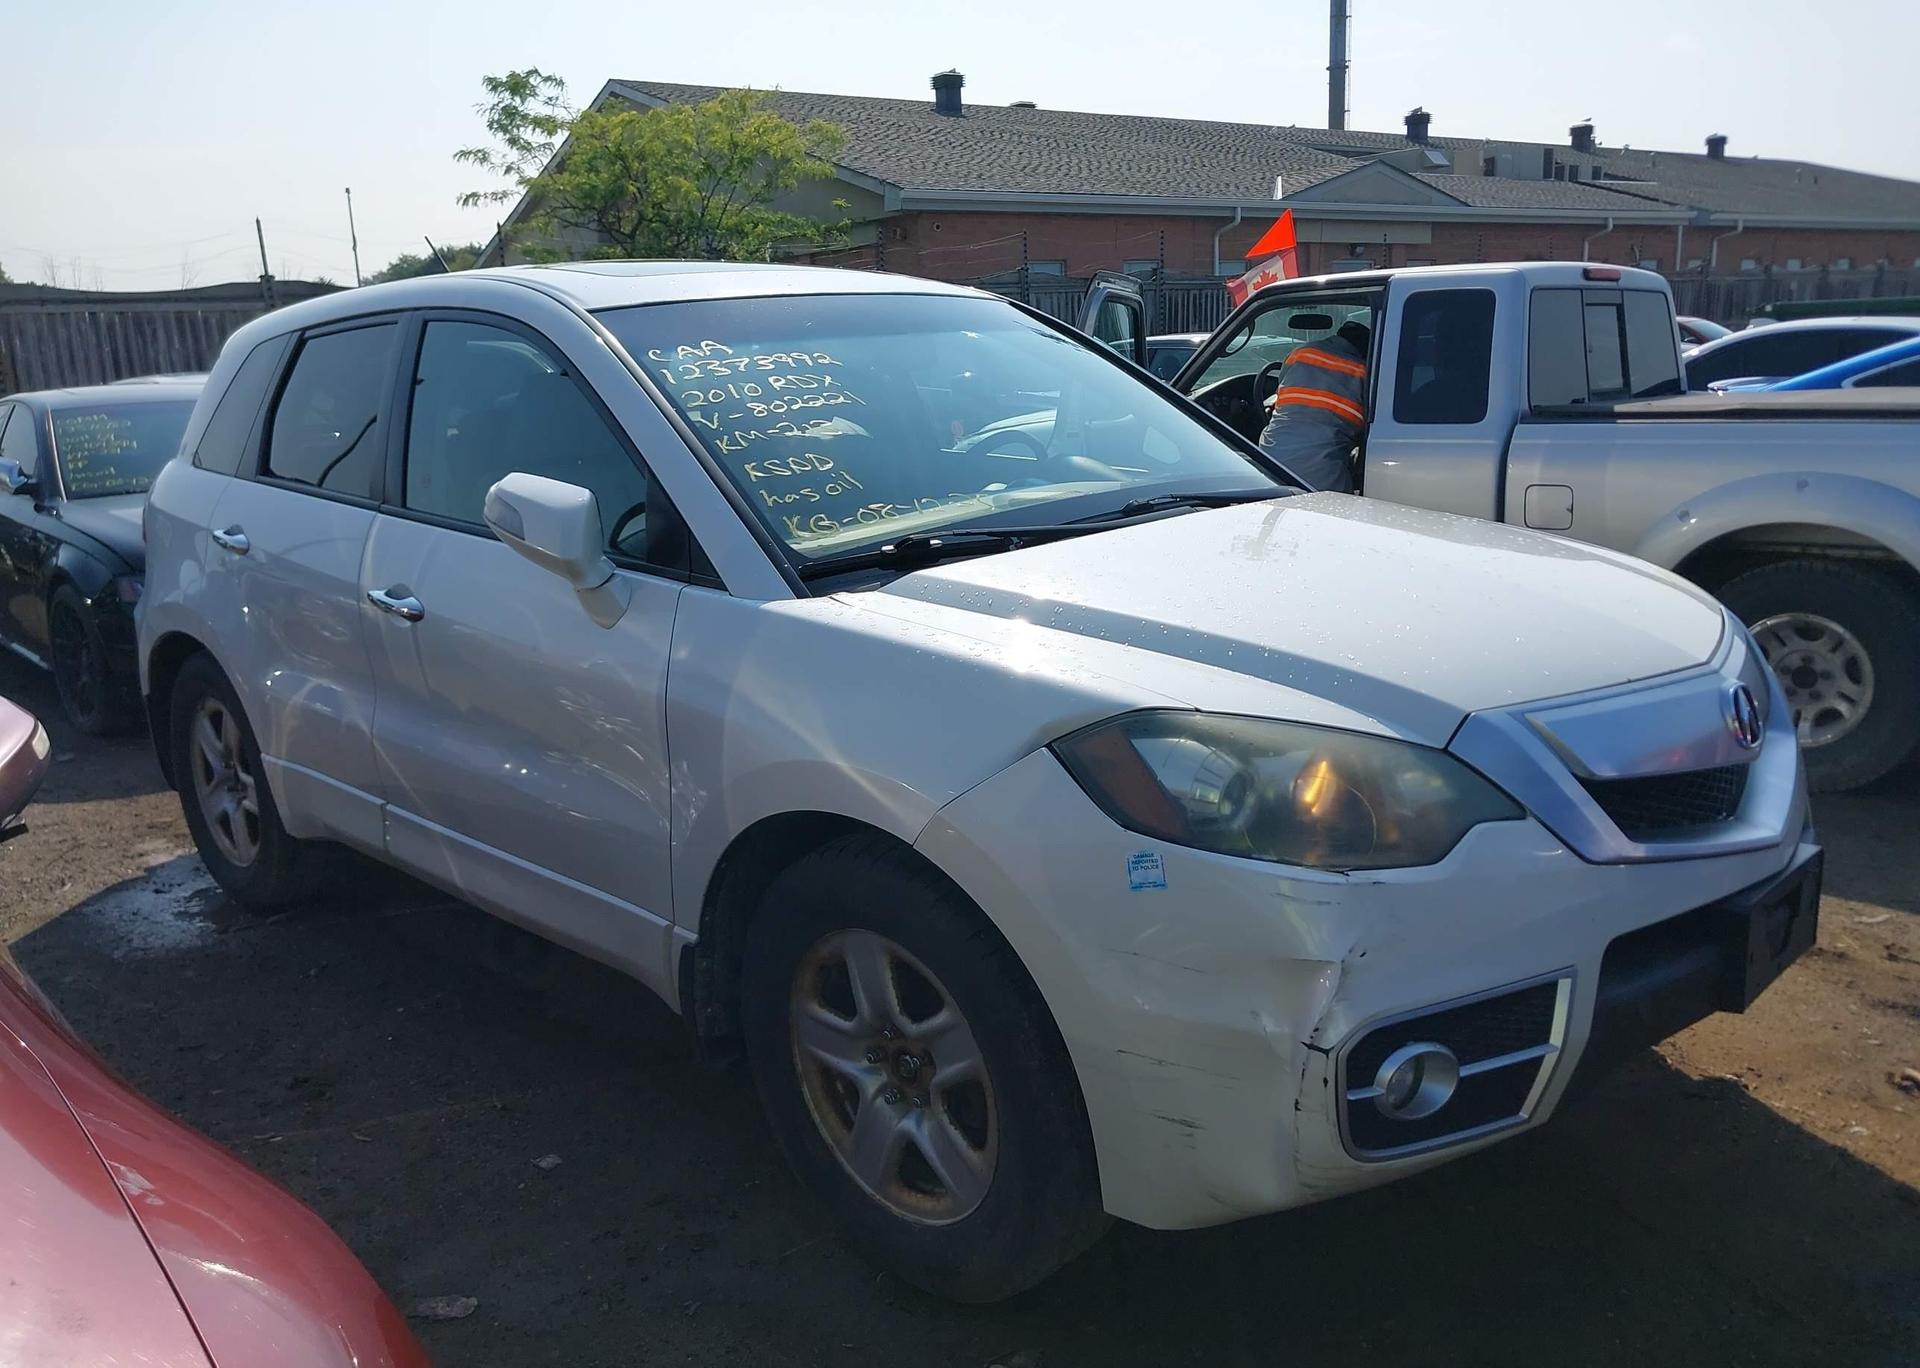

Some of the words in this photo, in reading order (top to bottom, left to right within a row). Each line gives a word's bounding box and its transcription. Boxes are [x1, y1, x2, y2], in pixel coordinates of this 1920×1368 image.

[648, 340, 733, 361] CAA
[661, 352, 843, 384] 12373992
[681, 382, 762, 407] 2010
[768, 375, 842, 391] RDX
[759, 488, 821, 507] has
[825, 470, 863, 496] oil
